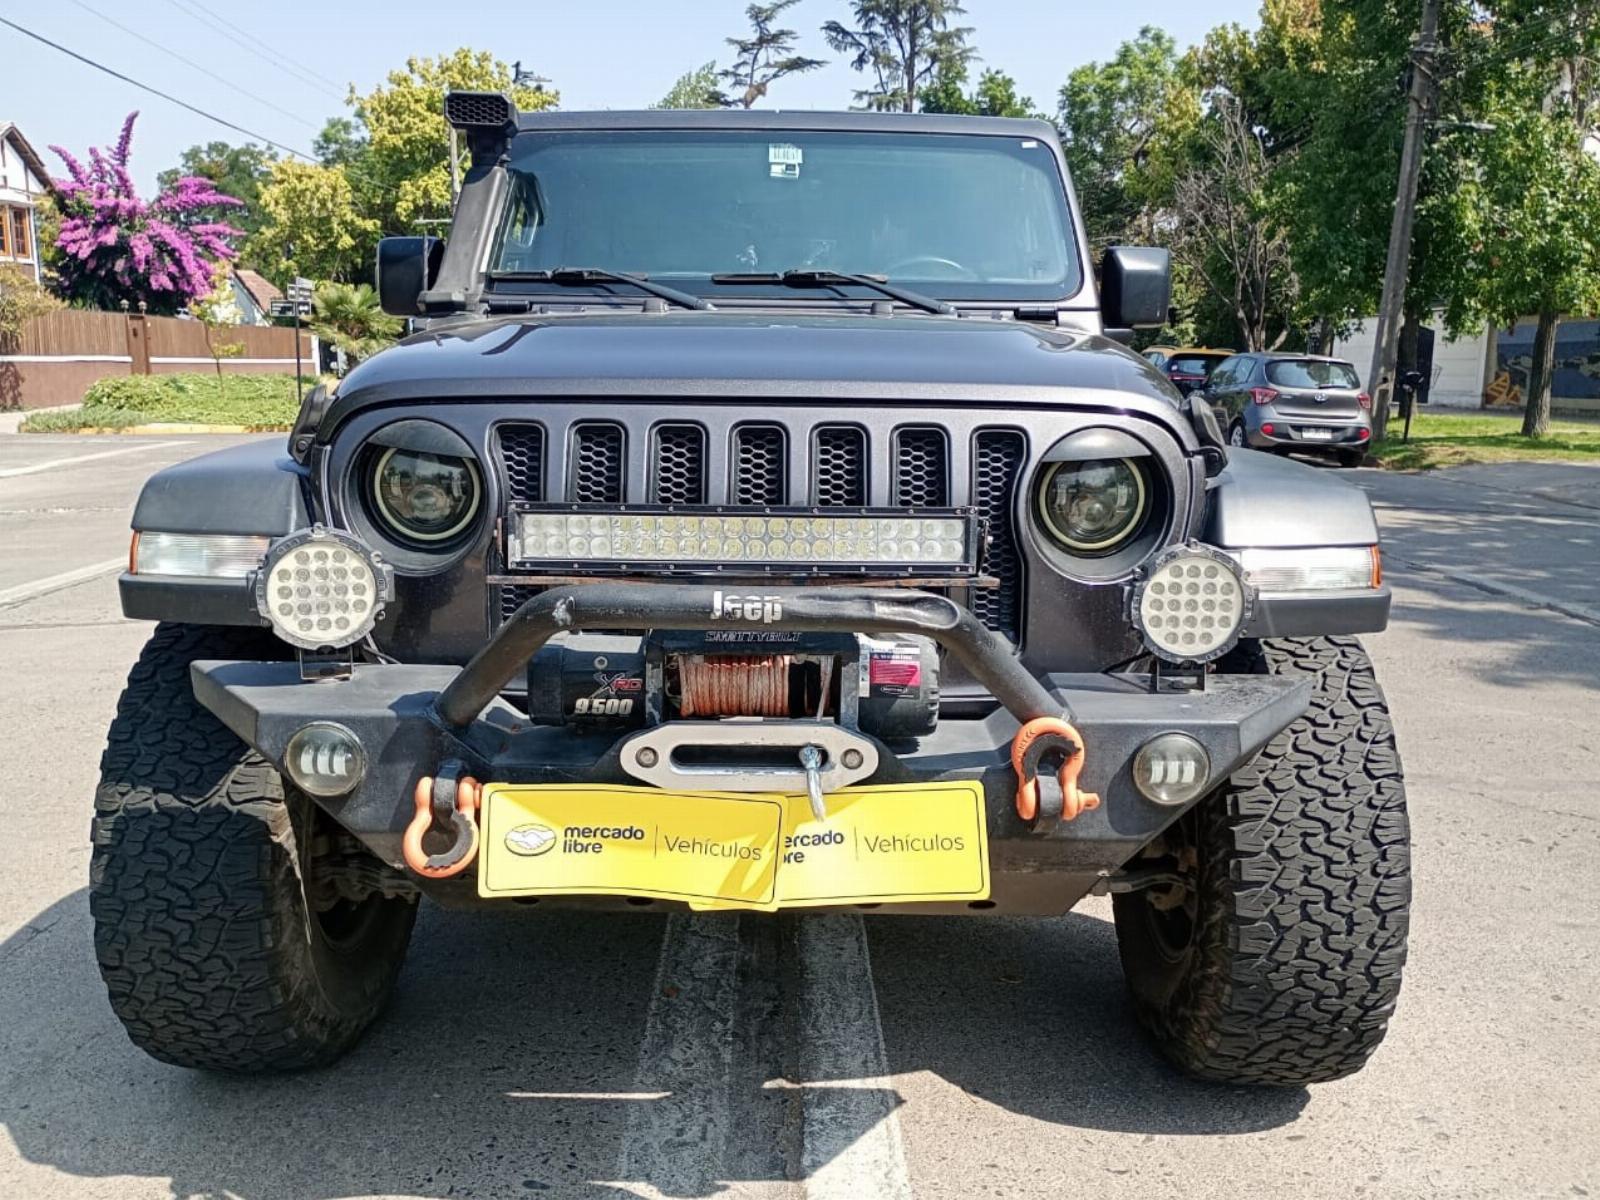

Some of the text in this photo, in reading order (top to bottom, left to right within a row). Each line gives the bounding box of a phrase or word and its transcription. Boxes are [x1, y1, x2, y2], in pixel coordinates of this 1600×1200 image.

[710, 591, 782, 623] Jeep
[564, 825, 645, 840] mercado
[784, 830, 845, 847] ercado
[563, 839, 602, 853] libre
[664, 834, 762, 861] Vehículos
[864, 833, 965, 853] Vehículos
